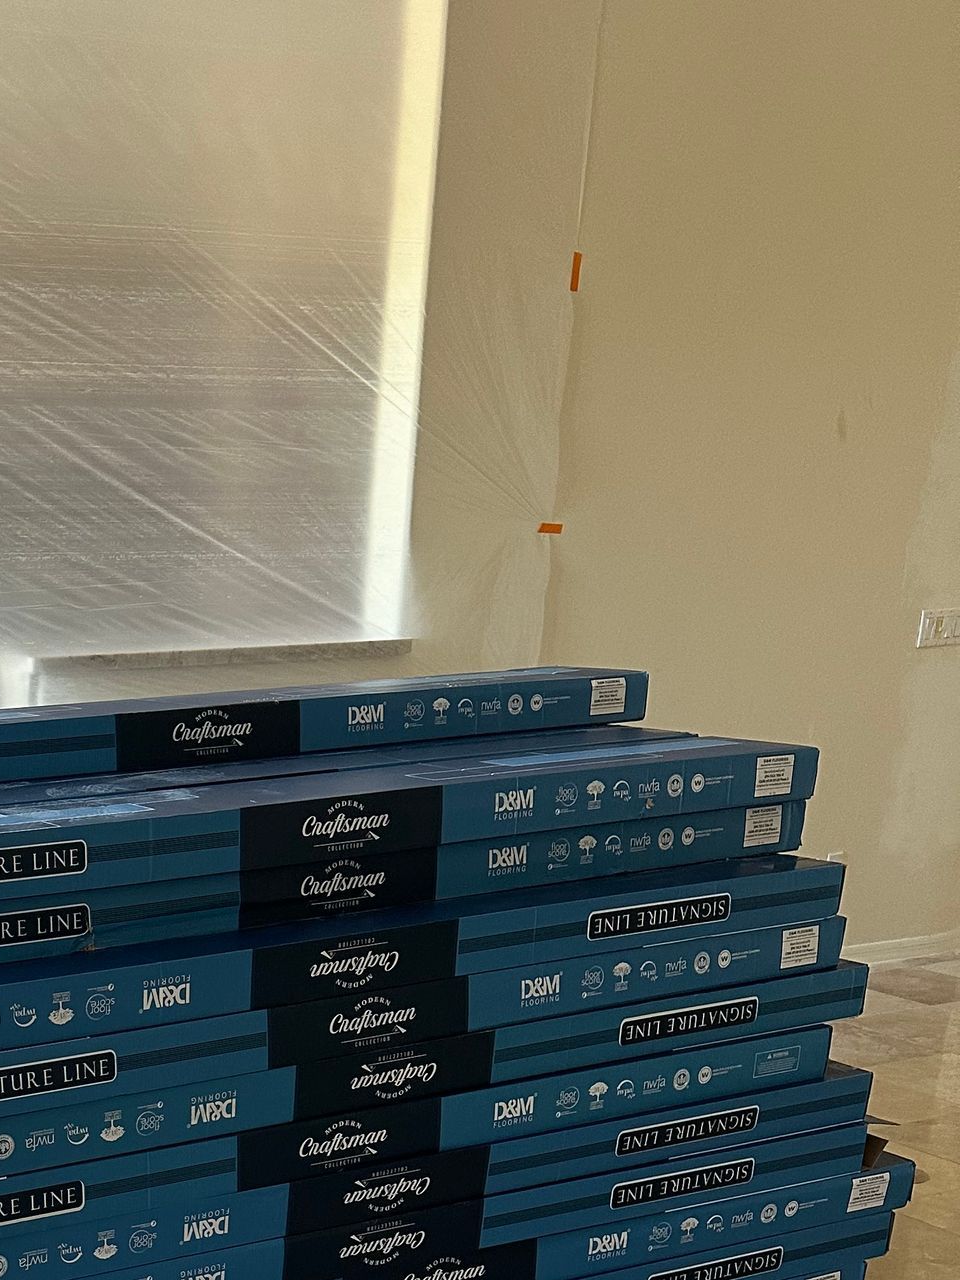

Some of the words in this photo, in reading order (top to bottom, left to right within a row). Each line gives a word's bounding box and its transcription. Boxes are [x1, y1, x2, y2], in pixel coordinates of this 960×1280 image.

[348, 704, 384, 725] D&M
[481, 697, 501, 712] nwfa
[195, 708, 230, 722] MODERN
[172, 721, 253, 744] Craftsman
[348, 723, 384, 733] FLOORING
[638, 778, 660, 795] nwfa
[327, 800, 364, 815] MODERN
[495, 788, 534, 812] D&M
[302, 811, 390, 838] Craftsman
[630, 832, 651, 849] nwfa
[33, 848, 79, 871] LINE
[488, 845, 527, 868] D&M
[325, 860, 362, 874] MODERN
[488, 866, 527, 877] FLOORING
[301, 871, 386, 897] Craftsman
[637, 899, 726, 927] SIGNATURE
[37, 912, 83, 935] LINE
[594, 915, 630, 934] LINE
[310, 950, 399, 978] Craftsman
[665, 957, 687, 974] nwfa
[143, 974, 191, 989] FLOORING
[335, 973, 374, 989] MODERN
[521, 975, 560, 999] D&M
[143, 983, 190, 1010] D&M
[354, 996, 391, 1012] MODERN
[520, 992, 560, 1007] FLOORING
[329, 1007, 416, 1034] Craftsman
[667, 1004, 754, 1032] SIGNATURE
[626, 1020, 661, 1040] LINE
[63, 1059, 110, 1082] LINE
[351, 1062, 437, 1090] Craftsman
[375, 1084, 411, 1099] MODERN
[643, 1074, 666, 1091] nwfa
[190, 1090, 237, 1103] FLOORING
[190, 1098, 236, 1125] D&M
[494, 1096, 535, 1121] D&M
[324, 1120, 362, 1135] MODERN
[493, 1115, 533, 1128] FLOORING
[665, 1112, 753, 1142] SIGNATURE
[25, 1133, 55, 1152] nwfa
[299, 1129, 388, 1157] Craftsman
[622, 1131, 659, 1151] LINE
[659, 1164, 749, 1195] SIGNATURE
[30, 1187, 77, 1211] LINE
[343, 1176, 430, 1205] Craftsman
[616, 1184, 654, 1204] LINE
[368, 1197, 404, 1212] MODERN
[184, 1208, 230, 1223] FLOORING
[731, 1209, 753, 1225] nwfa
[184, 1215, 230, 1241] D&M
[339, 1230, 426, 1259] Craftsman
[588, 1231, 628, 1255] D&M
[19, 1252, 48, 1270] nwfa
[363, 1251, 400, 1266] MODERN
[426, 1257, 462, 1271] MODERN
[588, 1249, 626, 1262] FLOORING
[180, 1263, 226, 1278] FLOORING
